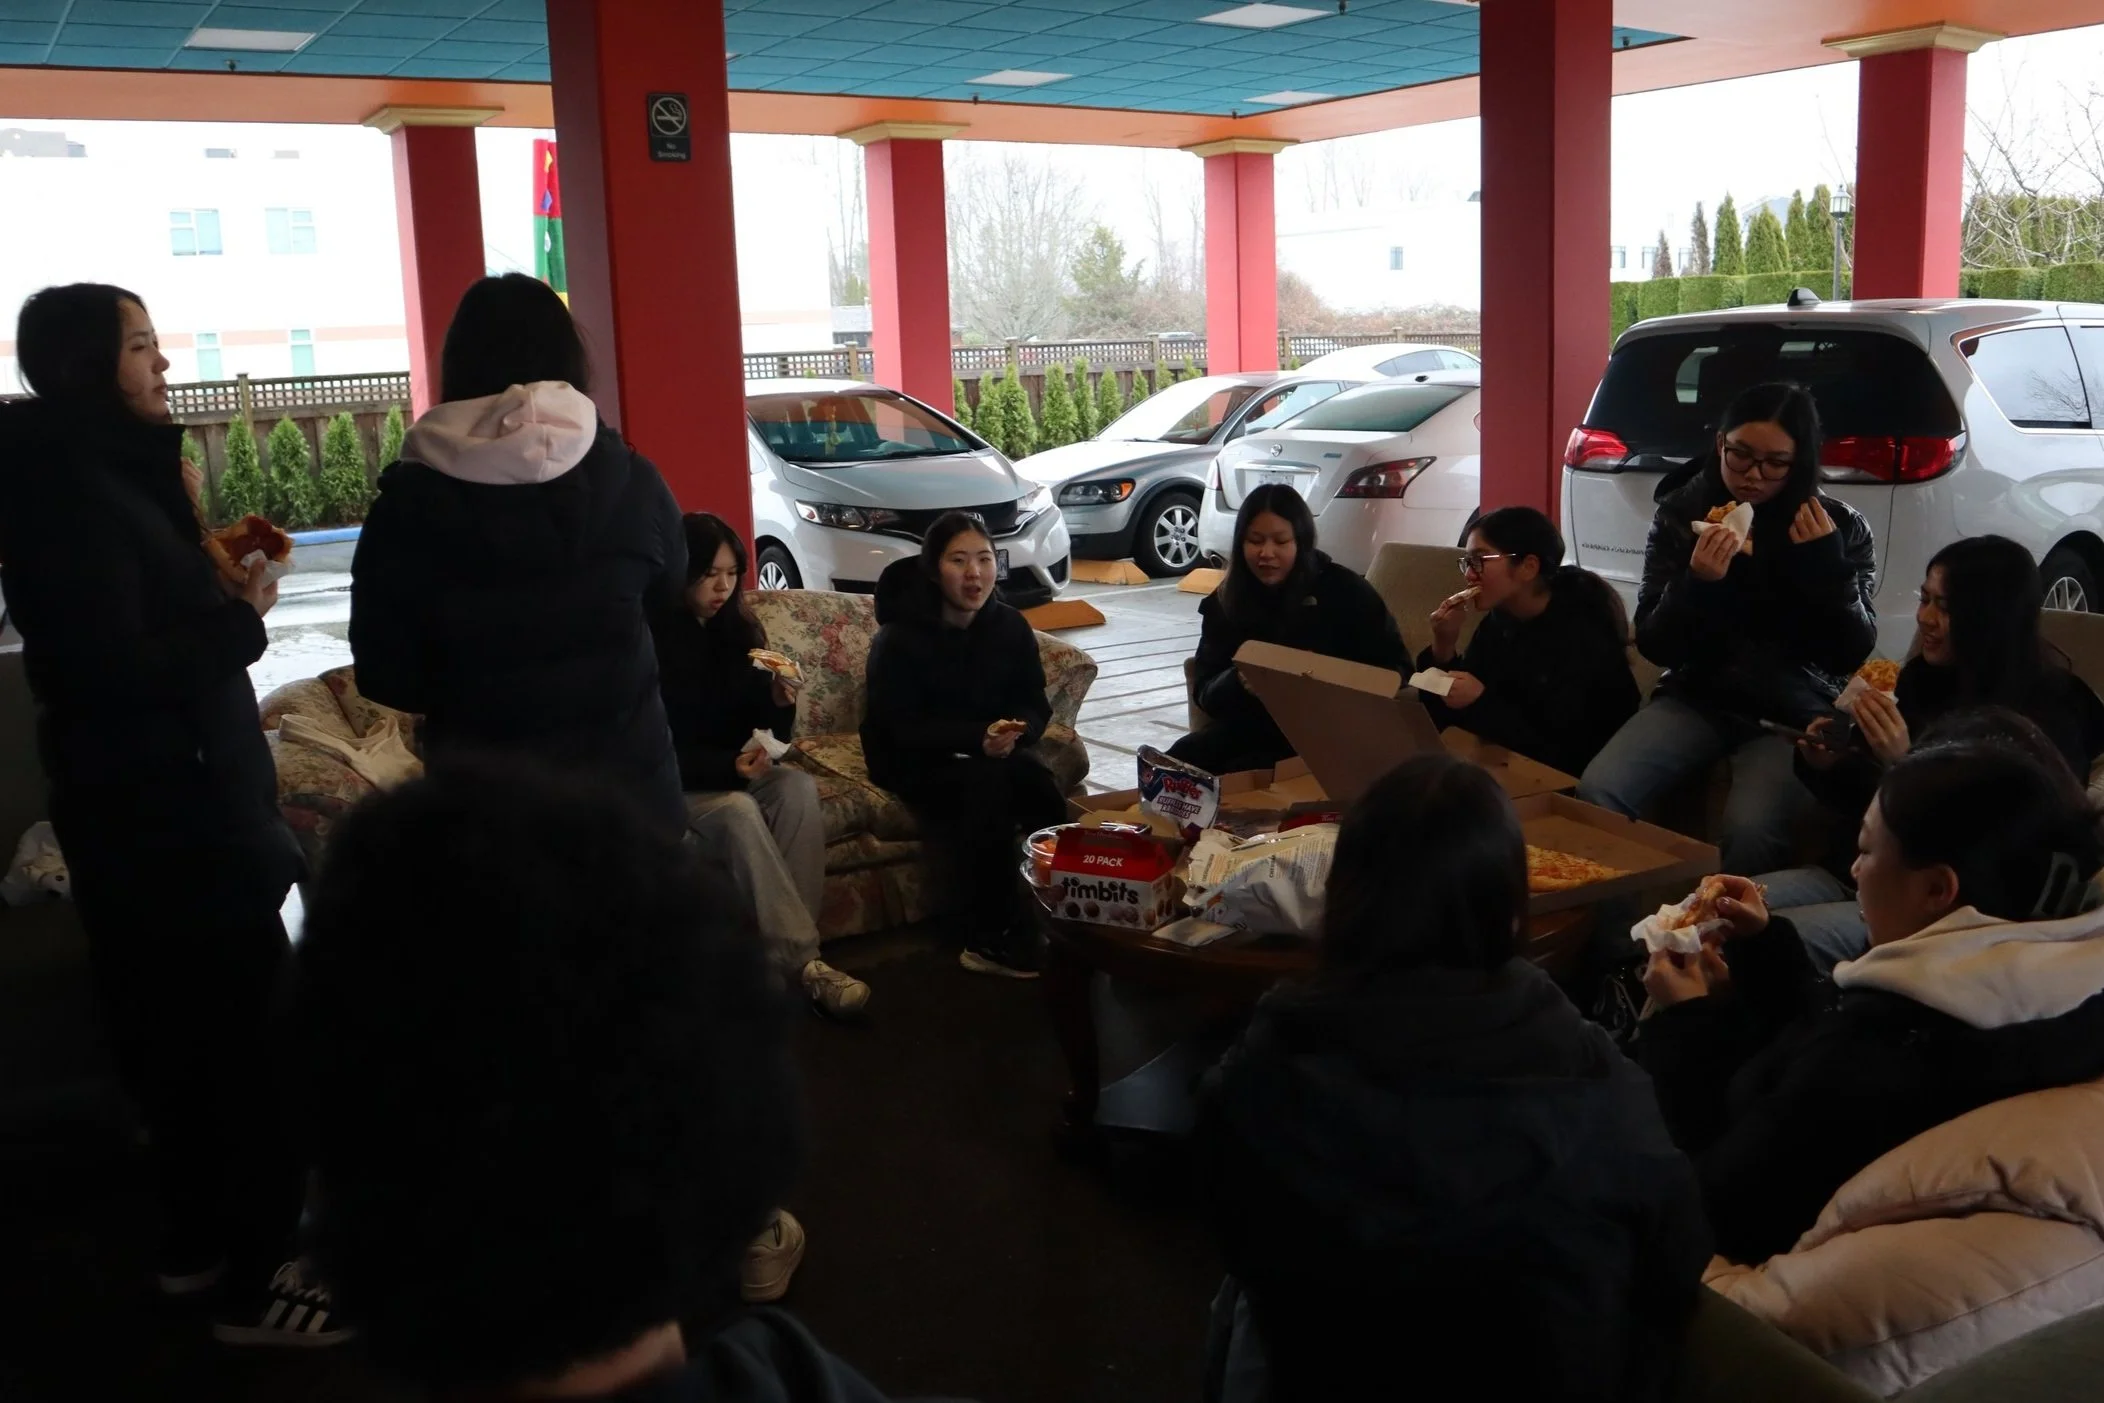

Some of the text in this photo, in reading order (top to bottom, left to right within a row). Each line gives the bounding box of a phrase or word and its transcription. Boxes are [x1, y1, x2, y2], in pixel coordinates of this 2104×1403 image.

[657, 151, 687, 160] Smoking
[1083, 855, 1124, 867] 20 PACK
[1062, 876, 1138, 904] timbits
